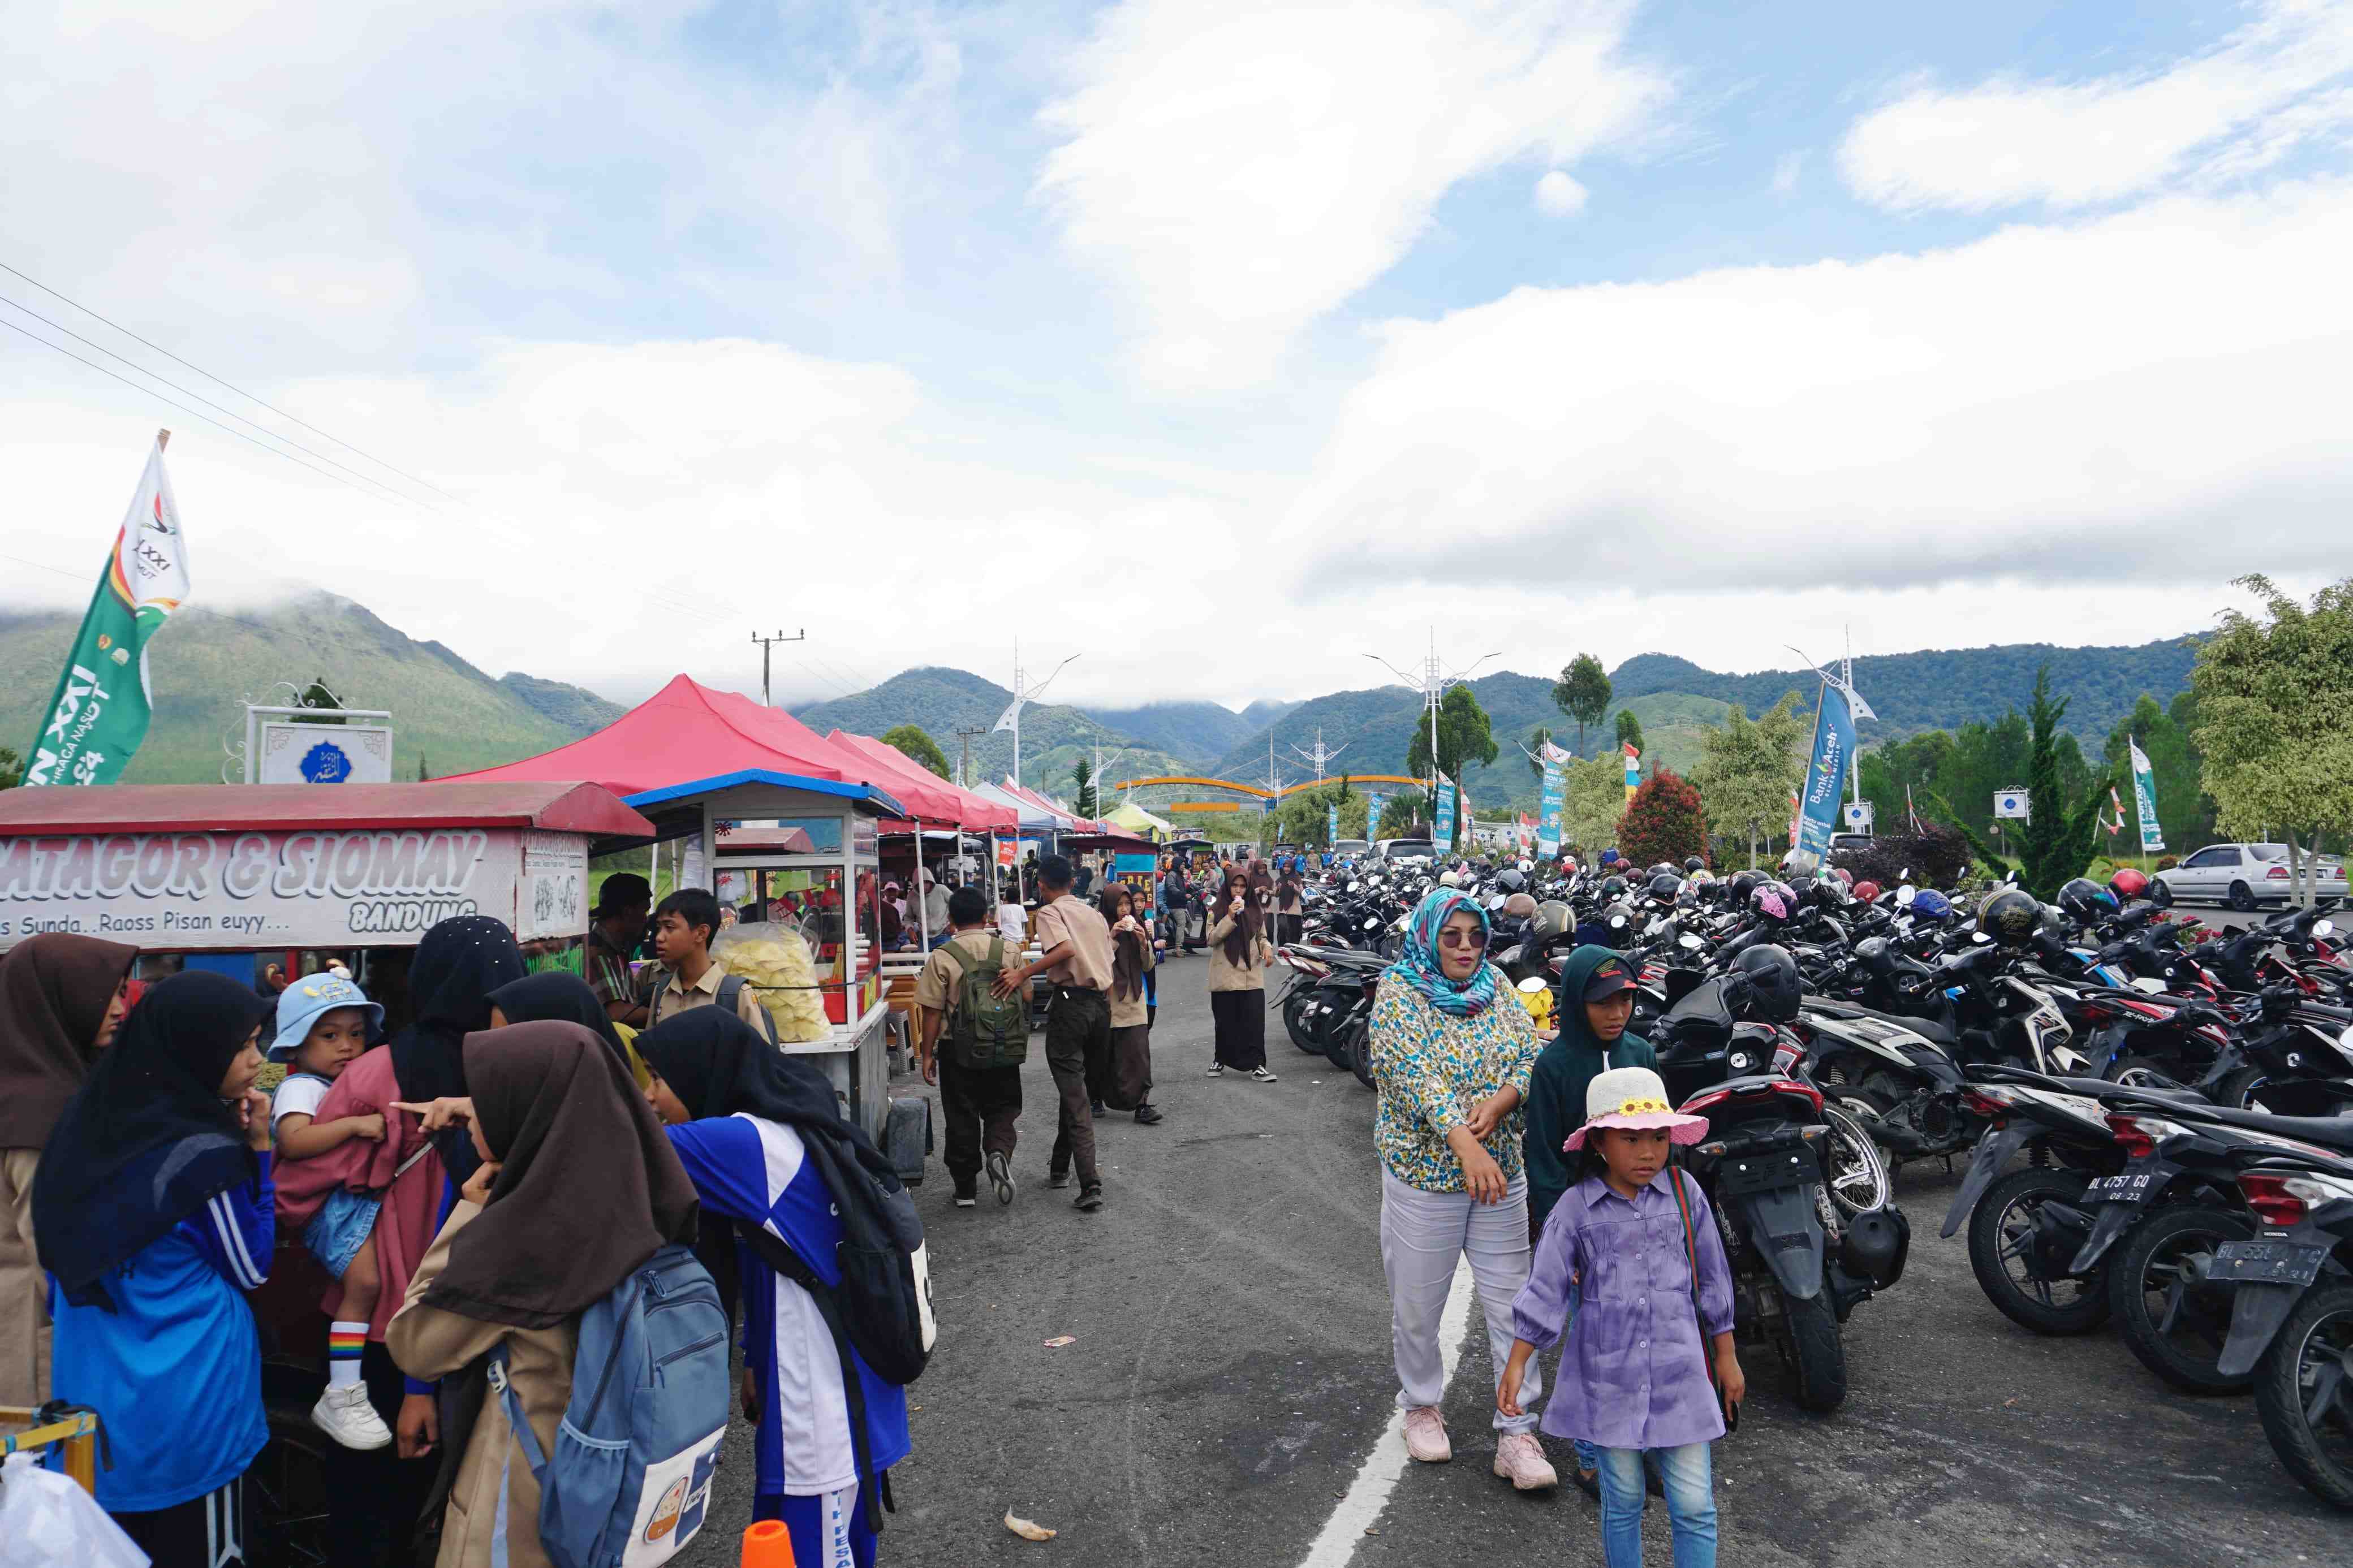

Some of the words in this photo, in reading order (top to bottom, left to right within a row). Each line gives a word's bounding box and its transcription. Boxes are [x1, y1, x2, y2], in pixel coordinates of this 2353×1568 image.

[1809, 774, 1829, 804] Bank
[1824, 731, 1838, 764] Aceh
[223, 831, 270, 899] &
[272, 828, 488, 899] SIOMAY
[163, 911, 212, 930] Pisan
[2088, 1177, 2101, 1189] BL
[2104, 1175, 2131, 1188] 4757
